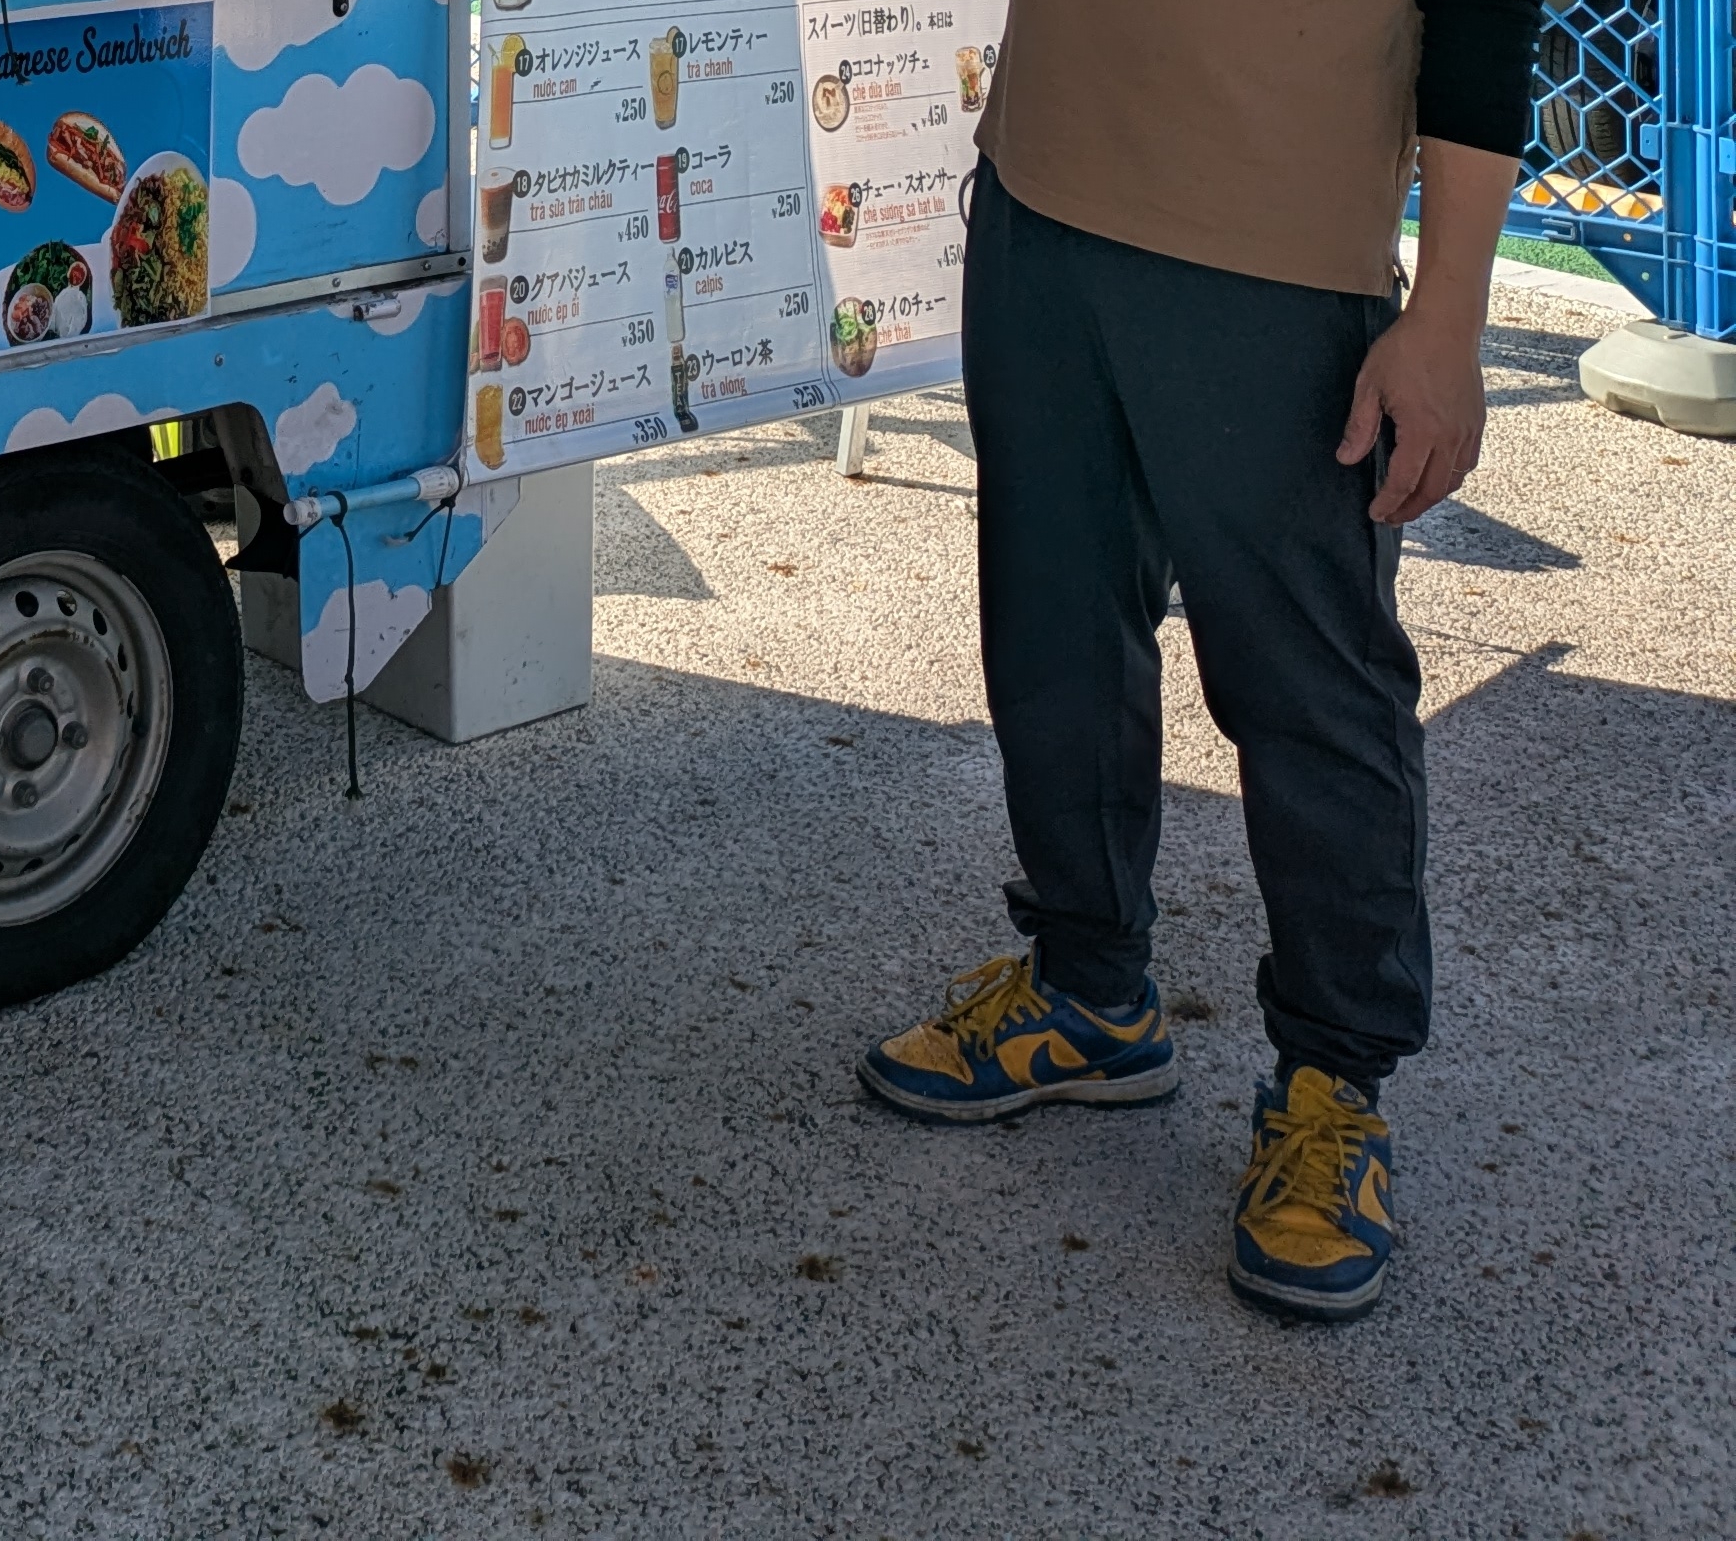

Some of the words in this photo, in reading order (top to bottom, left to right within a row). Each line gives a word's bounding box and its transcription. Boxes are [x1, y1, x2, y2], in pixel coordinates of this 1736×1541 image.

[927, 11, 954, 30] 本日は
[75, 18, 193, 74] Sandwich
[688, 27, 769, 54] レモンティー
[534, 37, 642, 75] オレンジジュース
[704, 56, 733, 77] chanh
[559, 77, 577, 95] cam
[765, 80, 795, 106] ¥250
[615, 96, 647, 123] ¥250
[691, 144, 733, 170] コーラ
[533, 155, 655, 198] タピオカミルクティー
[690, 179, 714, 197] coca
[771, 193, 802, 219] ¥250
[617, 215, 649, 242] ¥450
[695, 240, 755, 272] カルピス
[530, 260, 632, 304] グアバジュース
[695, 275, 724, 296] calpis
[779, 291, 810, 319] ¥250
[876, 291, 948, 323] タイのチェー
[621, 319, 655, 348] ¥350
[701, 338, 775, 376] ウーロン茶
[527, 363, 653, 409] マンゴージュース
[718, 377, 748, 399] olong
[633, 415, 669, 445] ¥350
